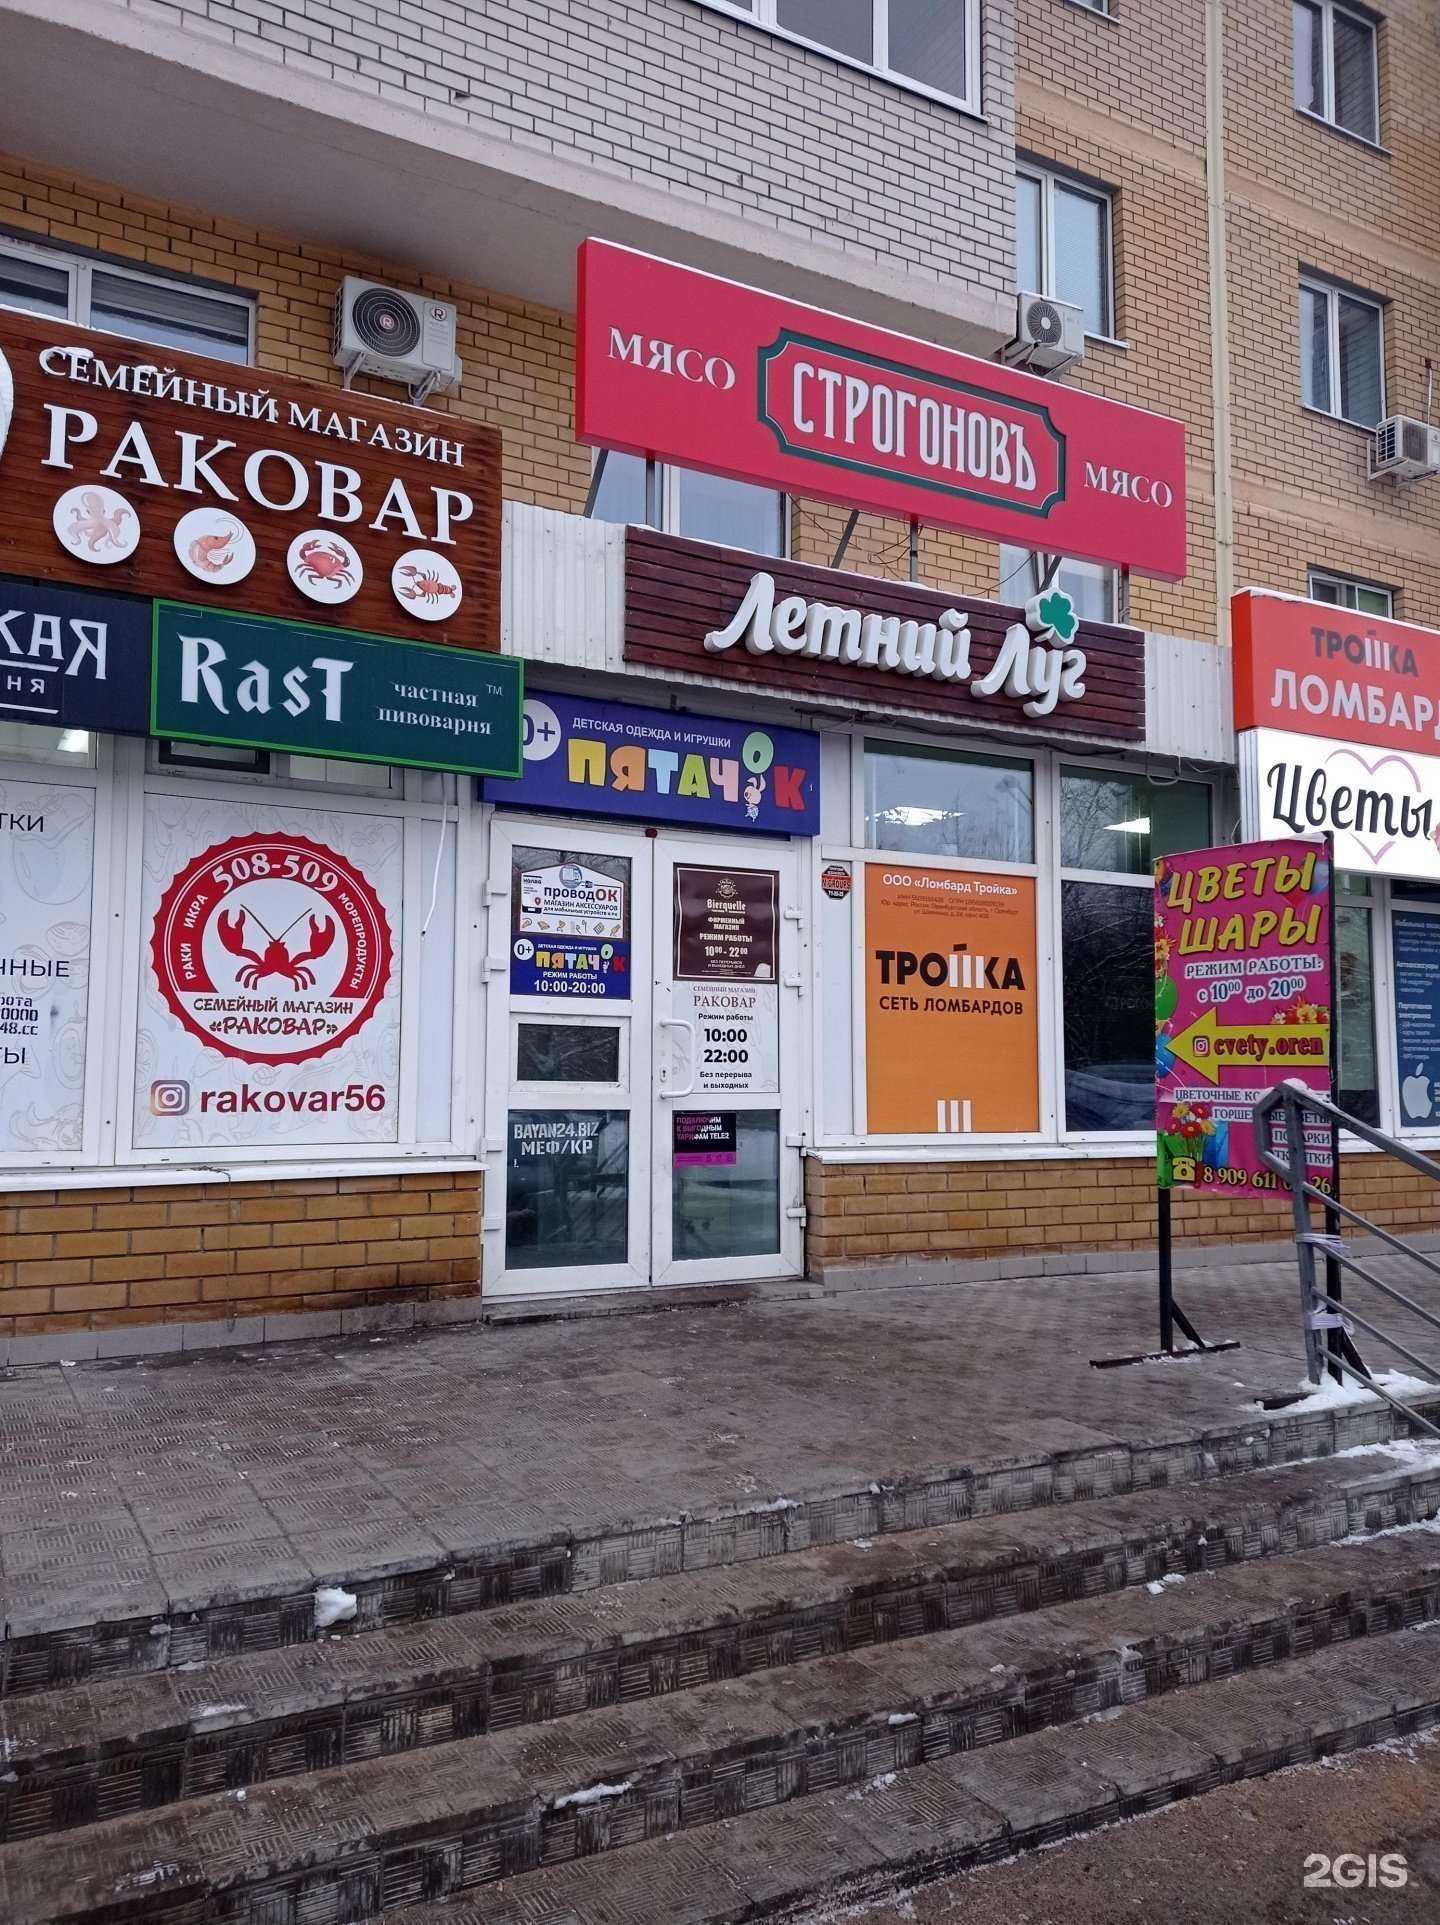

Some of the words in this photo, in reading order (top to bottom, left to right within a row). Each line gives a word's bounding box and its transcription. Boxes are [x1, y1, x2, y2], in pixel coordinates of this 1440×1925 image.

[607, 326, 737, 391] МЯСО
[38, 346, 280, 425] СЕМЕЙНЫЙ
[287, 402, 465, 468] МАГАЗИН
[792, 361, 1037, 492] СТРОГОНОВЪ
[40, 402, 474, 546] РАКОВАР
[1082, 461, 1174, 509] МЯСО
[703, 571, 973, 681] Летний
[970, 621, 1087, 718] Луг
[391, 682, 479, 708] частная
[377, 706, 492, 736] пивоварня
[572, 717, 624, 734] ДЕТСКАЯ
[626, 724, 672, 741] ОДЕЖДА
[674, 731, 682, 741] И
[684, 732, 731, 748] ИГРУШКИ
[567, 731, 806, 811] ПЯТАЧОК
[1266, 762, 1434, 841] Цветы
[212, 852, 339, 894] 508-509
[1166, 851, 1317, 914] ЦВЕТЫ
[543, 886, 618, 902] проводОК
[882, 873, 912, 887] ООО
[914, 876, 972, 894] «Ломбард
[974, 881, 1018, 897] Тройка»
[184, 893, 209, 929] ИКРА
[543, 899, 575, 908] МАГАЗИН
[575, 901, 618, 911] АКСЕССУАРОВ
[706, 898, 746, 912] Bierquelle
[707, 916, 745, 925] ФИРМЕННЫЙ
[713, 923, 740, 931] МАГАЗИН
[1178, 904, 1322, 956] ШАРЫ
[337, 892, 367, 990] МОРЕПРОДУКТЫ
[699, 932, 724, 941] РЕЖИМ
[724, 934, 753, 943] РАБОТЫ
[516, 943, 532, 956] 0+
[535, 944, 625, 973] ПЯТАЧОК
[180, 942, 197, 980] РАКИ
[875, 943, 1026, 991] ТРОЙКА
[1186, 961, 1243, 978] РЕЖИМ
[1248, 956, 1323, 974] РАБОТЫ:
[533, 979, 606, 994] 10:00-20:00
[543, 971, 568, 979] РЕЖИМ
[569, 972, 598, 980] РАБОТЫ
[693, 985, 727, 993] СЕМЕЙНЫЙ
[728, 986, 756, 994] МАГАЗИН
[1199, 989, 1207, 1001] с
[1247, 987, 1264, 1002] до
[193, 996, 279, 1012] СЕМЕЙНЫЙ
[282, 1000, 354, 1014] МАГАЗИН
[693, 995, 756, 1008] РАКОВАР
[879, 995, 919, 1011] СЕТЬ
[923, 997, 1024, 1016] ЛОМБАРДОВ
[208, 1016, 338, 1036] «РАКОВАР»
[726, 1013, 754, 1021] работы
[703, 1028, 748, 1043] 10:00
[703, 1048, 749, 1064] 22:00
[1213, 1034, 1324, 1062] cvety.oren
[710, 1082, 749, 1090] выходных
[1175, 1088, 1242, 1102] ЦВЕТОЧНЫЕ
[199, 1083, 386, 1113] rakovar56
[513, 1121, 600, 1139] BAYAN24.BIZ
[710, 1132, 731, 1140] TELE2
[521, 1139, 593, 1155] МЕФ/КР
[1203, 1167, 1213, 1183] 8
[1217, 1167, 1248, 1186] 909
[1251, 1171, 1277, 1190] 611
